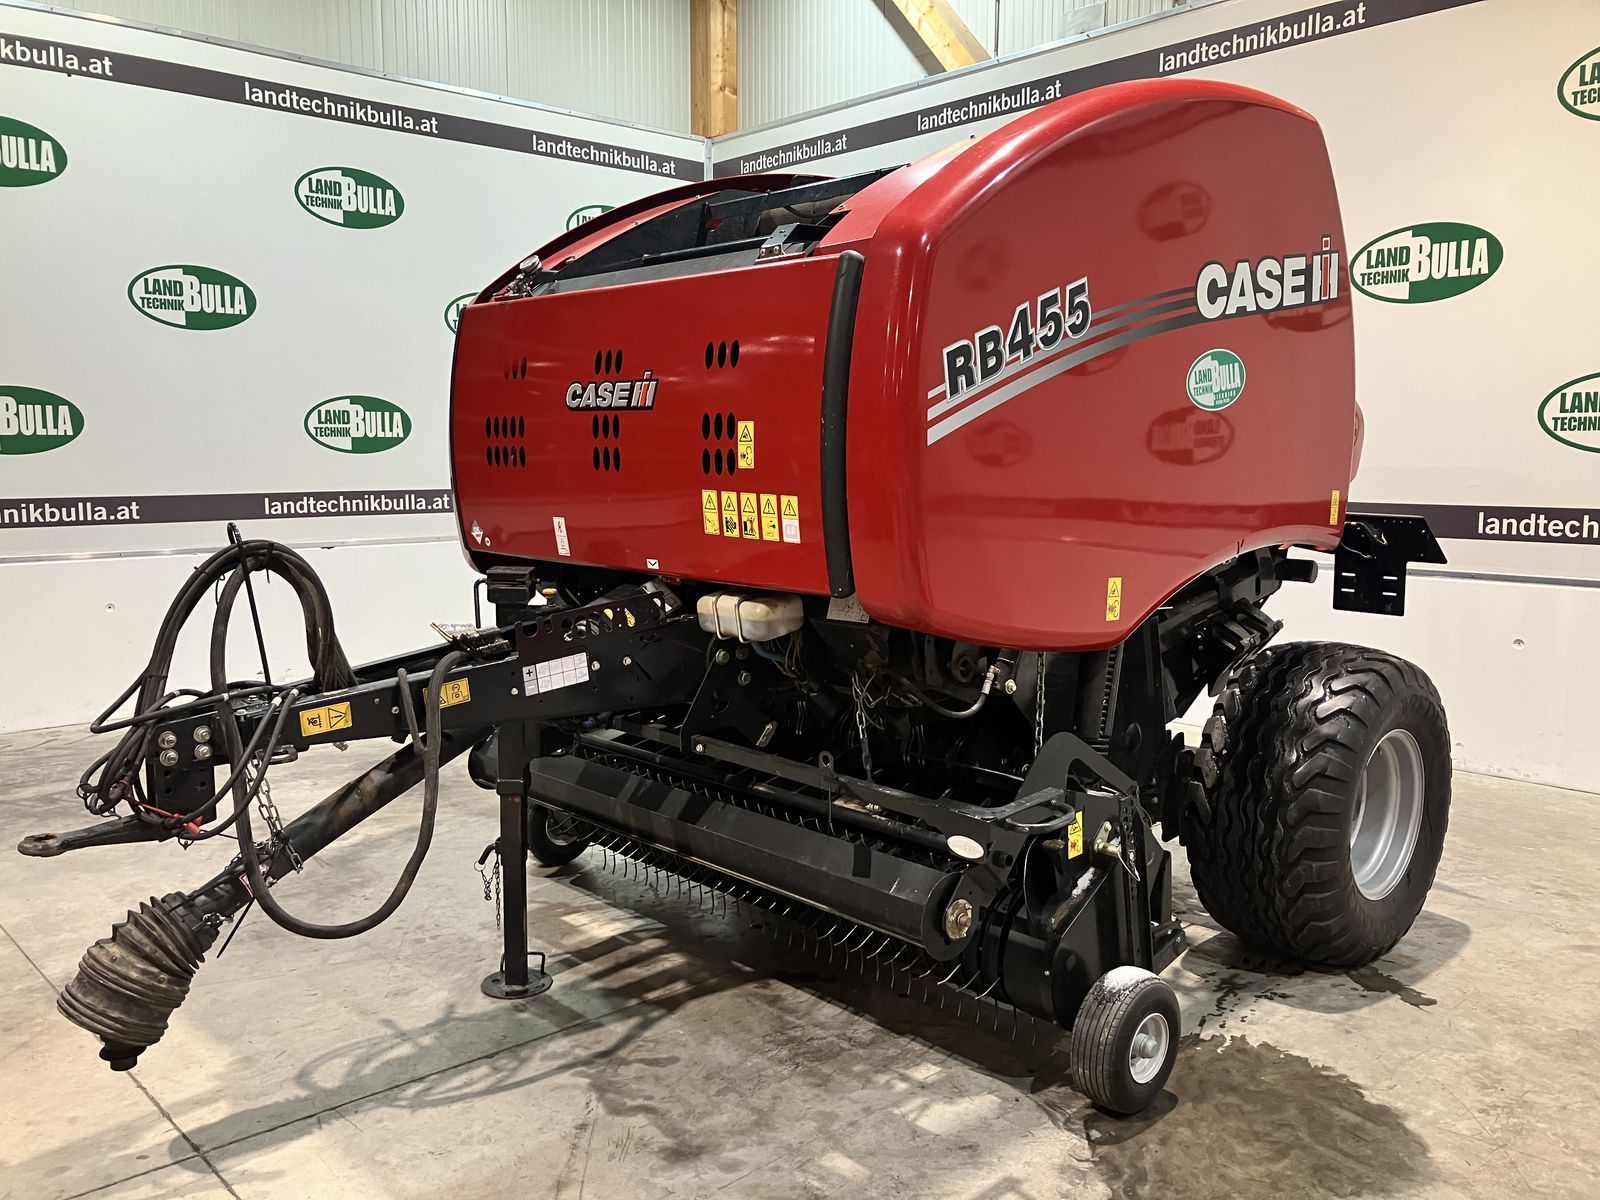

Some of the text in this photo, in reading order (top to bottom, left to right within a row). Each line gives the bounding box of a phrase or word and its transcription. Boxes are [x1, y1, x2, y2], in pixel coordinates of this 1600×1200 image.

[1158, 2, 1367, 73] landtechnikbulla.at
[244, 81, 438, 133] landtechnikbulla.at
[917, 79, 1062, 132] landtechnikbulla.at
[0, 134, 57, 173] ULLA
[532, 134, 676, 175] landtechnikbulla.at
[740, 133, 847, 175] landtechnikbulla.at
[308, 177, 343, 197] LAND
[342, 175, 397, 216] BULLA
[304, 194, 343, 210] TECHNIK
[1366, 245, 1411, 270] LAND
[1409, 236, 1489, 282] BULLA
[143, 277, 184, 298] LAND
[1196, 256, 1307, 320] CASE
[1360, 268, 1410, 287] TECHNIK
[139, 296, 186, 312] TECHNIK
[183, 274, 248, 316] BULLA
[943, 276, 1092, 401] RB455
[1194, 368, 1212, 384] LAND
[1211, 360, 1241, 392] BULLA
[565, 382, 632, 408] CASE
[1559, 391, 1600, 414] LAN
[317, 409, 351, 425] LAND
[349, 404, 404, 438] BULLA
[313, 426, 351, 438] TECHNIK
[0, 501, 141, 524] nikbulla.at
[264, 493, 450, 515] landtechnikbulla.at
[1477, 511, 1600, 539] landtech
